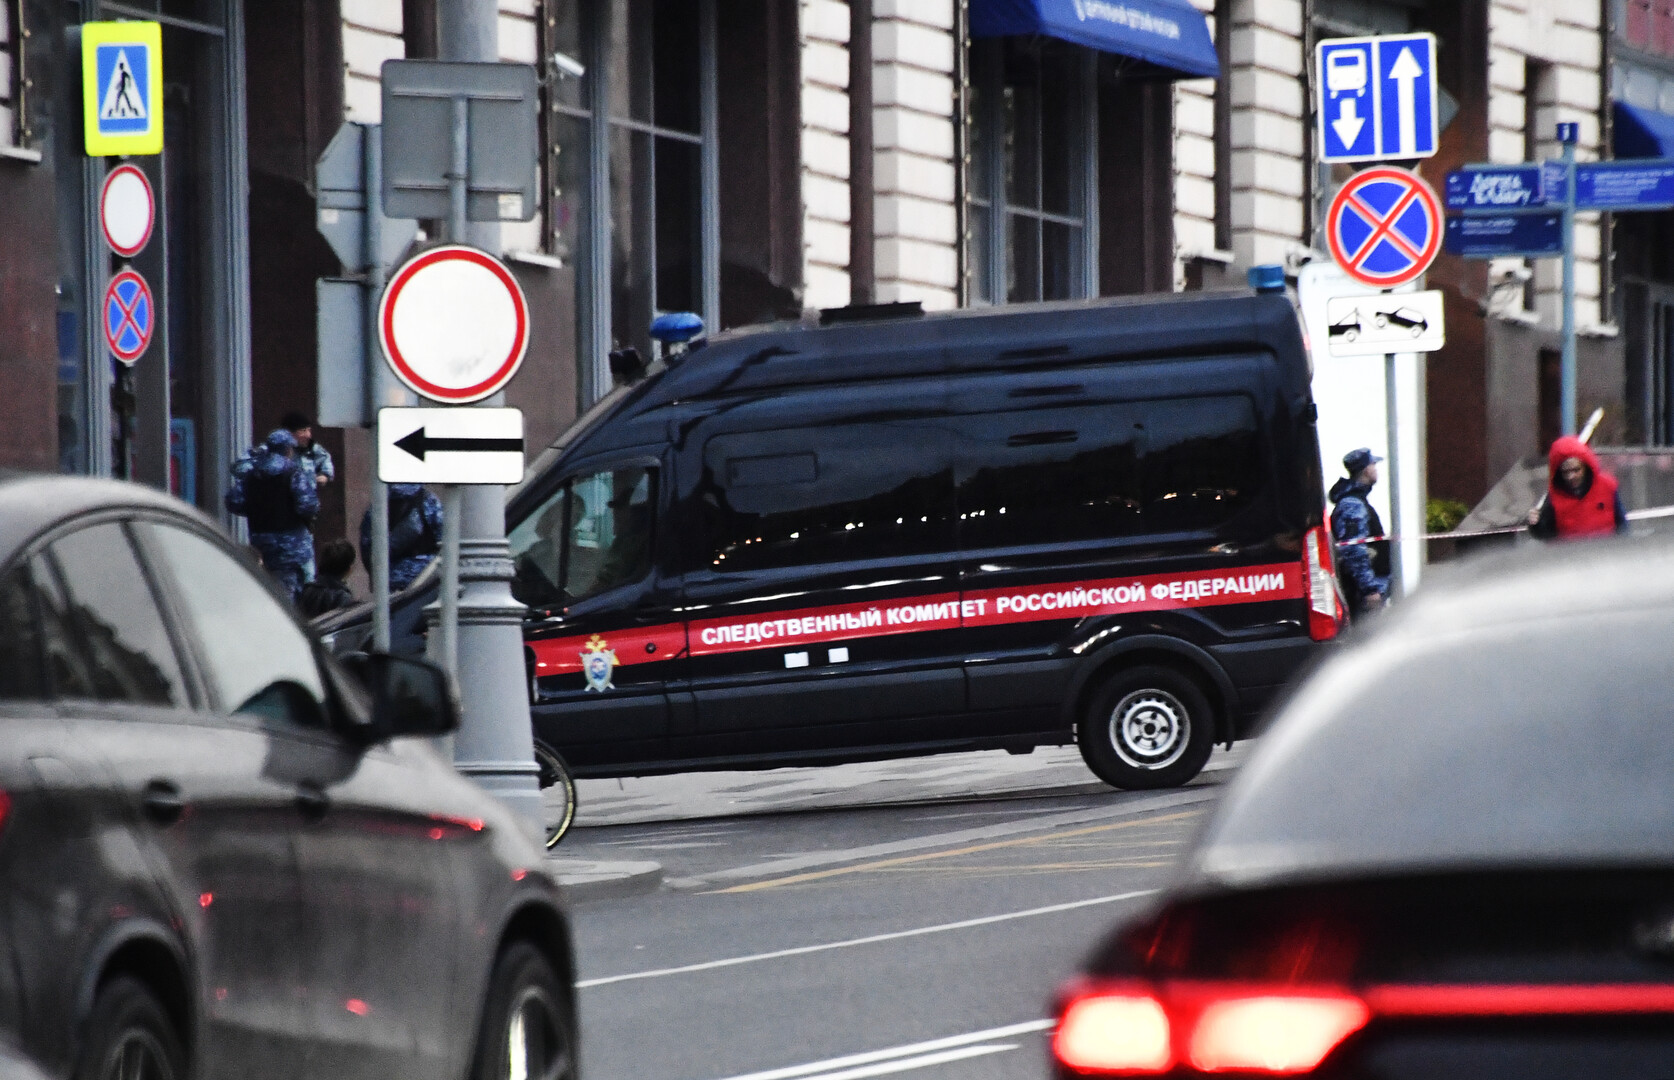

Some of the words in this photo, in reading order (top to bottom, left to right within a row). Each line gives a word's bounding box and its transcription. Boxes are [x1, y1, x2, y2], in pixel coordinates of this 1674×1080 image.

[701, 608, 881, 644] СЛЕДСТВЕННЫЙ
[887, 599, 987, 624] КОМИТЕТ
[997, 583, 1145, 613] РОССИЙСКОЙ
[1151, 573, 1284, 601] ФЕДЕРАЦИИ
